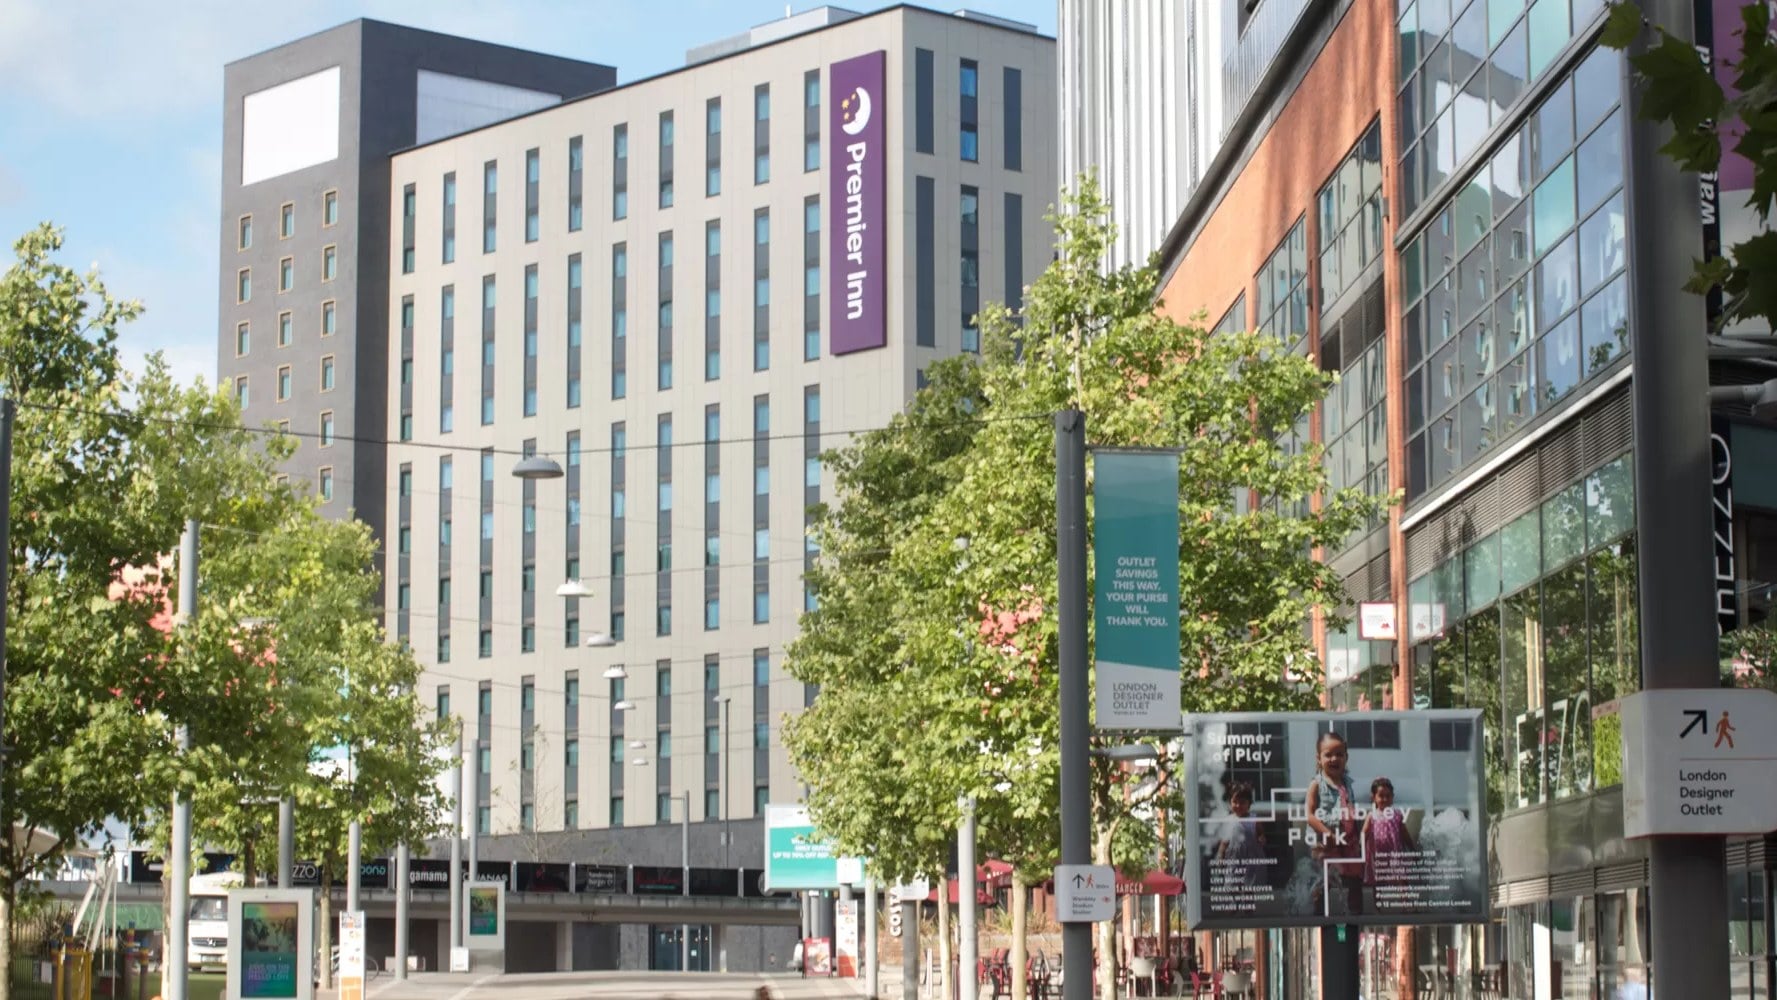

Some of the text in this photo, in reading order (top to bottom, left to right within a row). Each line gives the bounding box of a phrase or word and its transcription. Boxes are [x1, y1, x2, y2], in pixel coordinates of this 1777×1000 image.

[846, 141, 867, 320] Premier Inn
[1117, 556, 1157, 567] OUTLET
[1115, 568, 1158, 579] SAVINGS
[1112, 580, 1135, 590] THIS
[1106, 592, 1168, 603] YOUR PURSE
[1125, 605, 1149, 614] WILL
[1106, 616, 1141, 626] THANK
[1112, 682, 1157, 692] LONDON
[1112, 692, 1164, 701] DESIGNER
[1112, 701, 1150, 710] OUTLET
[1206, 731, 1272, 746] Summer
[1212, 747, 1272, 764] of Play
[1679, 768, 1727, 781] London
[1679, 786, 1735, 801] Designer
[1287, 801, 1411, 823] Wembley
[1680, 803, 1723, 816] Outlet
[1288, 827, 1348, 846] Park
[1209, 858, 1240, 866] OUTDOOR
[292, 864, 316, 879] ZZO
[1210, 867, 1233, 875] STREET
[409, 870, 448, 884] gamama
[1224, 876, 1245, 884] MUSIC
[1210, 885, 1240, 893] PARKOUR
